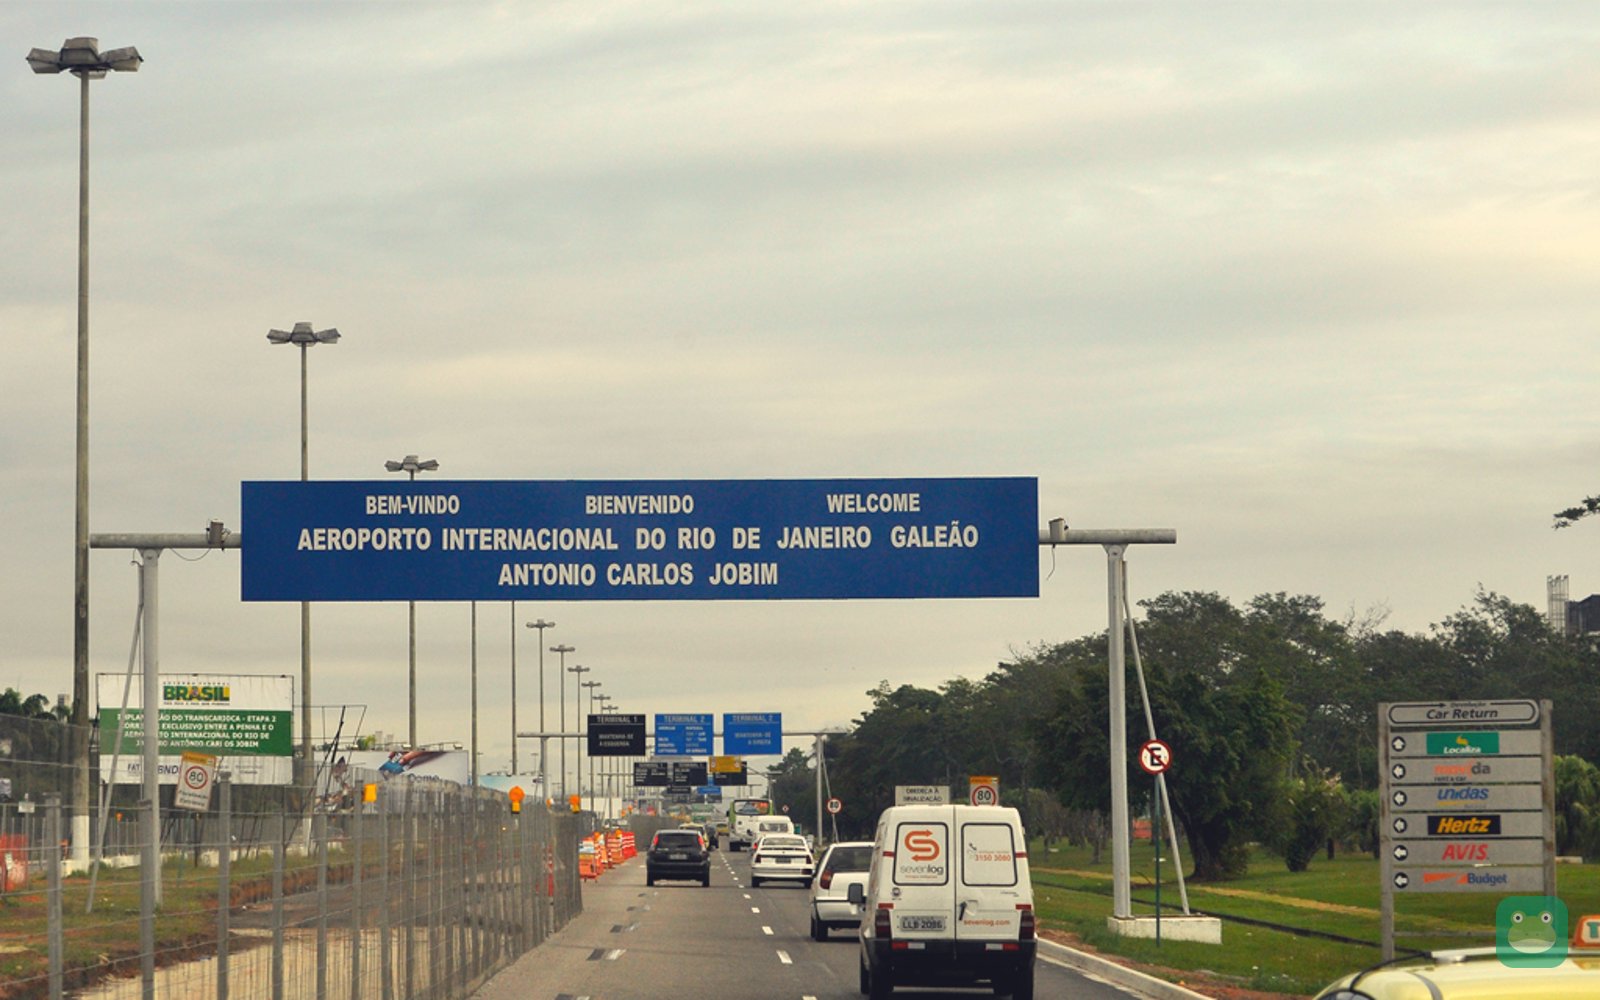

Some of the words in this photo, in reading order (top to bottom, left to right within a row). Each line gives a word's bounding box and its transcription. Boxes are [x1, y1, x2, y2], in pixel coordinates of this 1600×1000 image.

[366, 495, 460, 515] BEM-VINDO
[585, 495, 694, 514] BIENVENIDO
[827, 493, 920, 513] WELCOME
[298, 528, 431, 550] AEROPORTO
[442, 528, 618, 550] INTERNACIONAL
[636, 528, 666, 549] DO
[678, 527, 716, 549] RIO
[733, 527, 760, 549] DE
[777, 526, 871, 549] JANEIRO
[890, 520, 979, 548] GALEÃO
[498, 563, 596, 586] ANTONIO
[607, 563, 694, 585] CARLOS
[709, 563, 778, 585] JOBIM
[163, 685, 231, 701] BRASIL
[184, 713, 240, 722] TRANSCARIOCA
[1426, 709, 1448, 720] Car
[1452, 708, 1498, 719] Return
[171, 731, 231, 739] INTERNACIONAL
[189, 771, 204, 782] 80
[977, 790, 991, 800] 80
[1437, 787, 1489, 800] unidas
[1437, 817, 1491, 833] Hertz
[1442, 844, 1488, 860] AVIS
[1467, 873, 1507, 886] Budget
